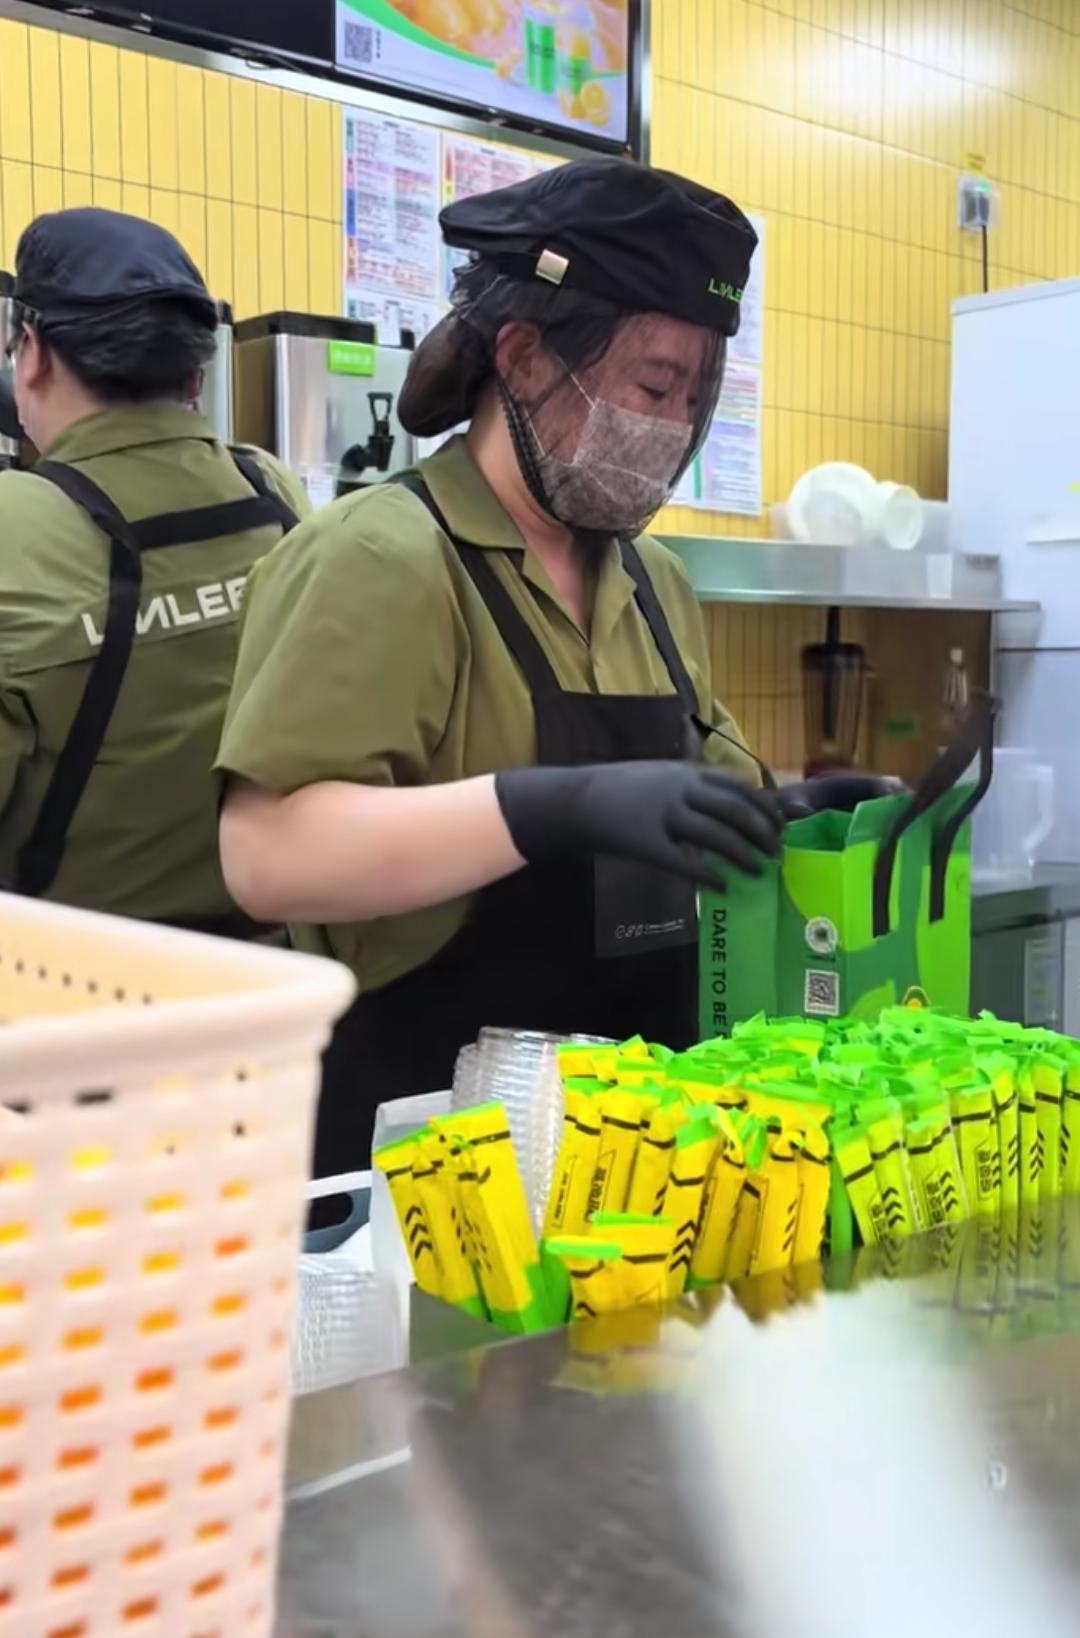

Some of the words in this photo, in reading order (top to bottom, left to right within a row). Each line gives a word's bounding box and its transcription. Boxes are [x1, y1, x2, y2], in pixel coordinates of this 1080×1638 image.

[711, 909, 728, 962] DARE
[711, 967, 728, 994] TO
[711, 1000, 728, 1027] BE
